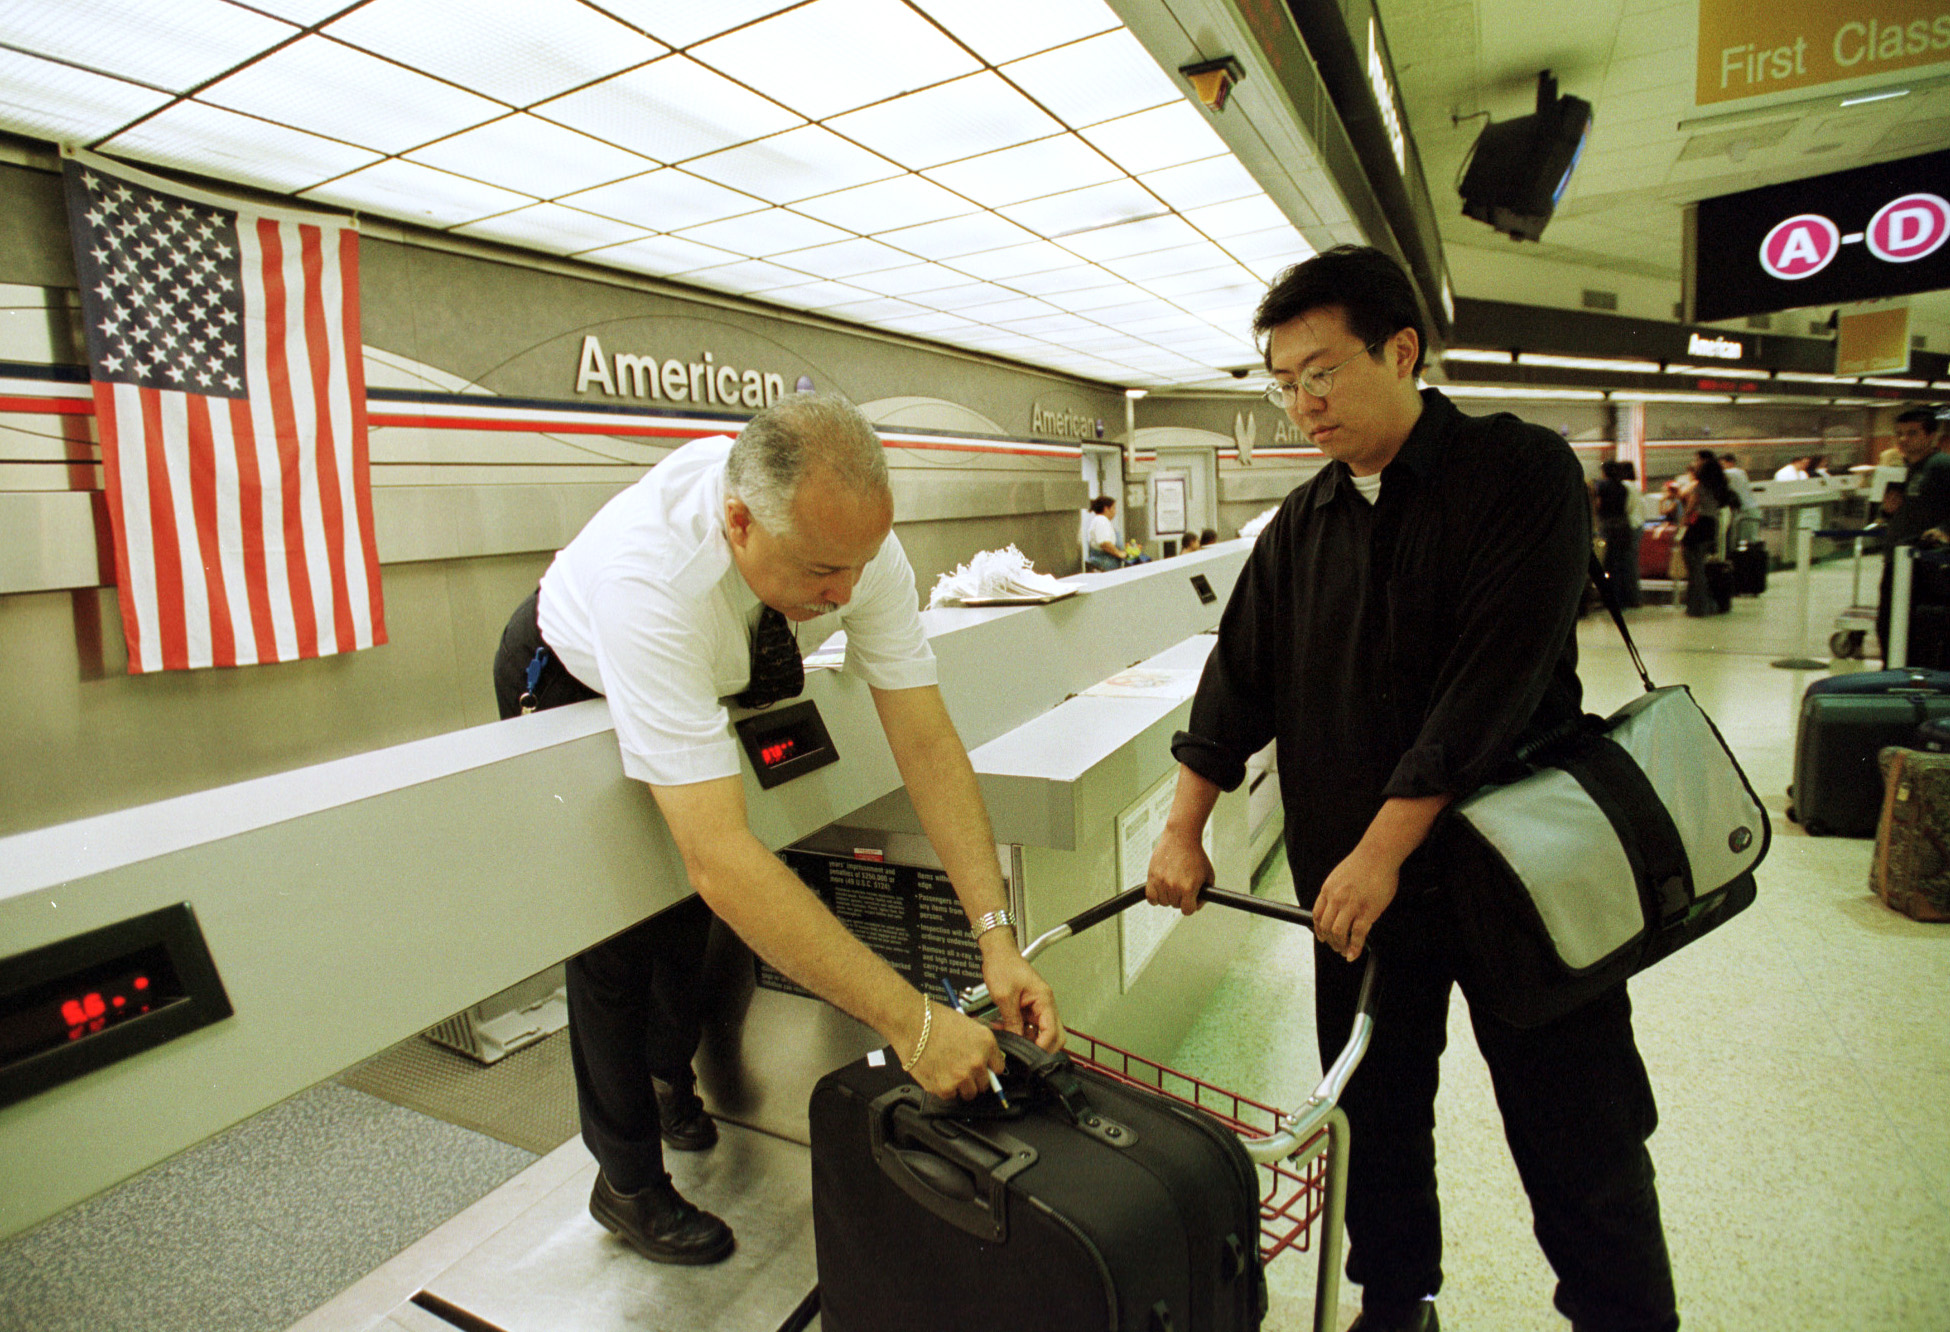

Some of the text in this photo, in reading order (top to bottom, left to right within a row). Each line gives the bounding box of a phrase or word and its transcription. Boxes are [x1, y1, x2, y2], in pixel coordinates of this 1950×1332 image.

[1720, 14, 1950, 89] First Class
[576, 335, 785, 408] American
[1031, 402, 1096, 438] American
